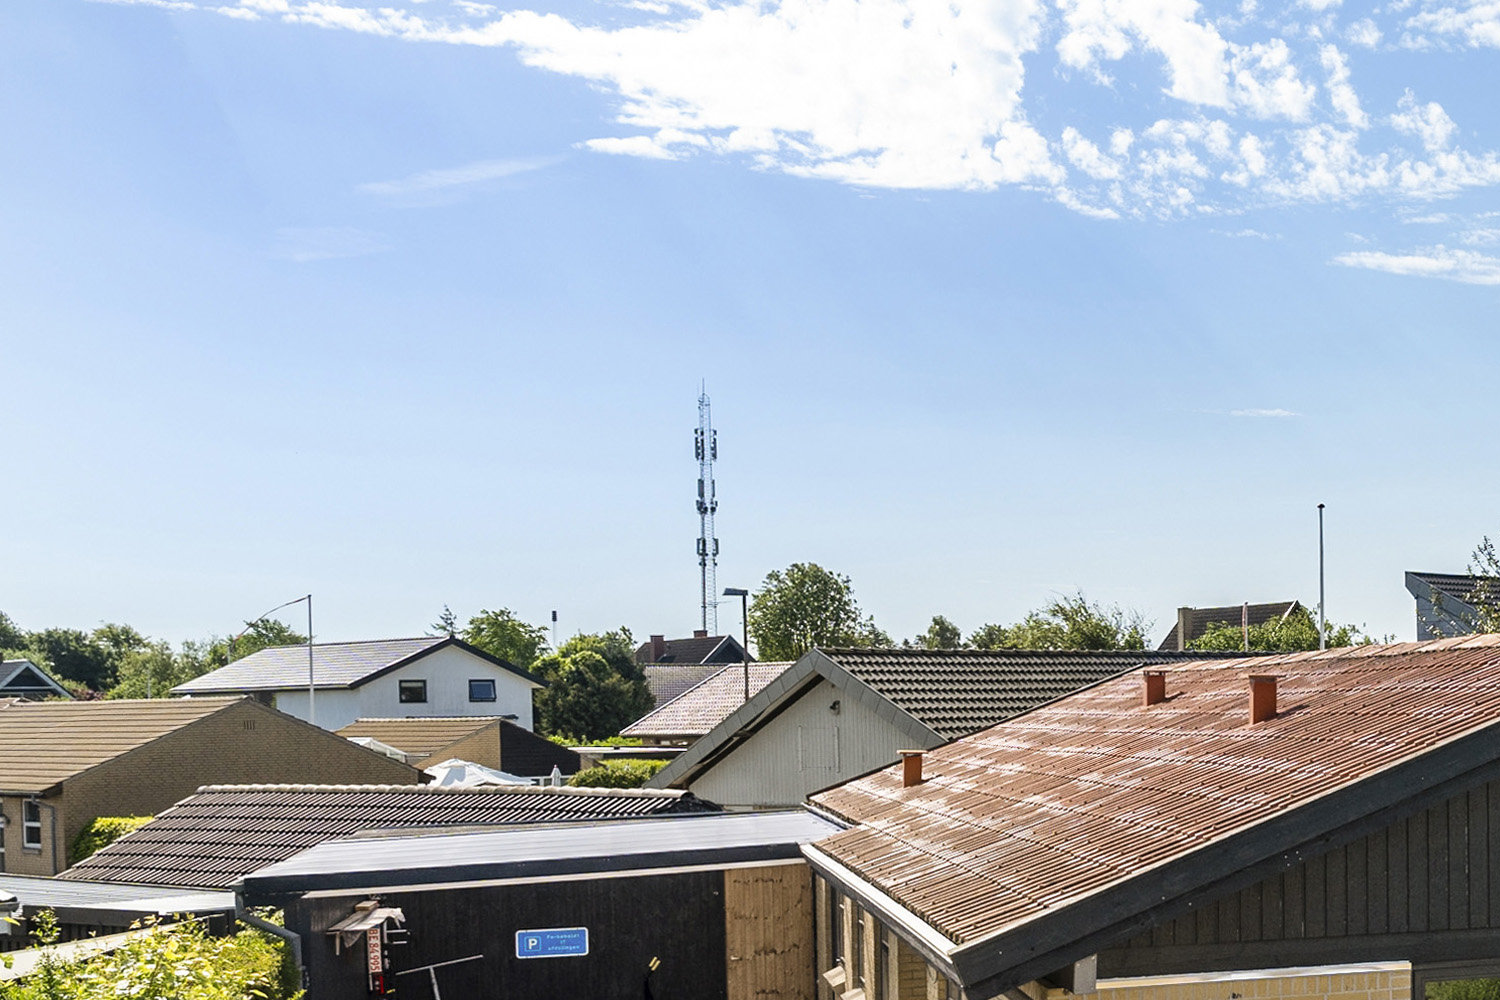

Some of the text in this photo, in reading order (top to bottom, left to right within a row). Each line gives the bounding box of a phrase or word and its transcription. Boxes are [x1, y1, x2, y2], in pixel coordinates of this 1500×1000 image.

[369, 929, 381, 970] BE 84 995
[528, 938, 538, 950] P
